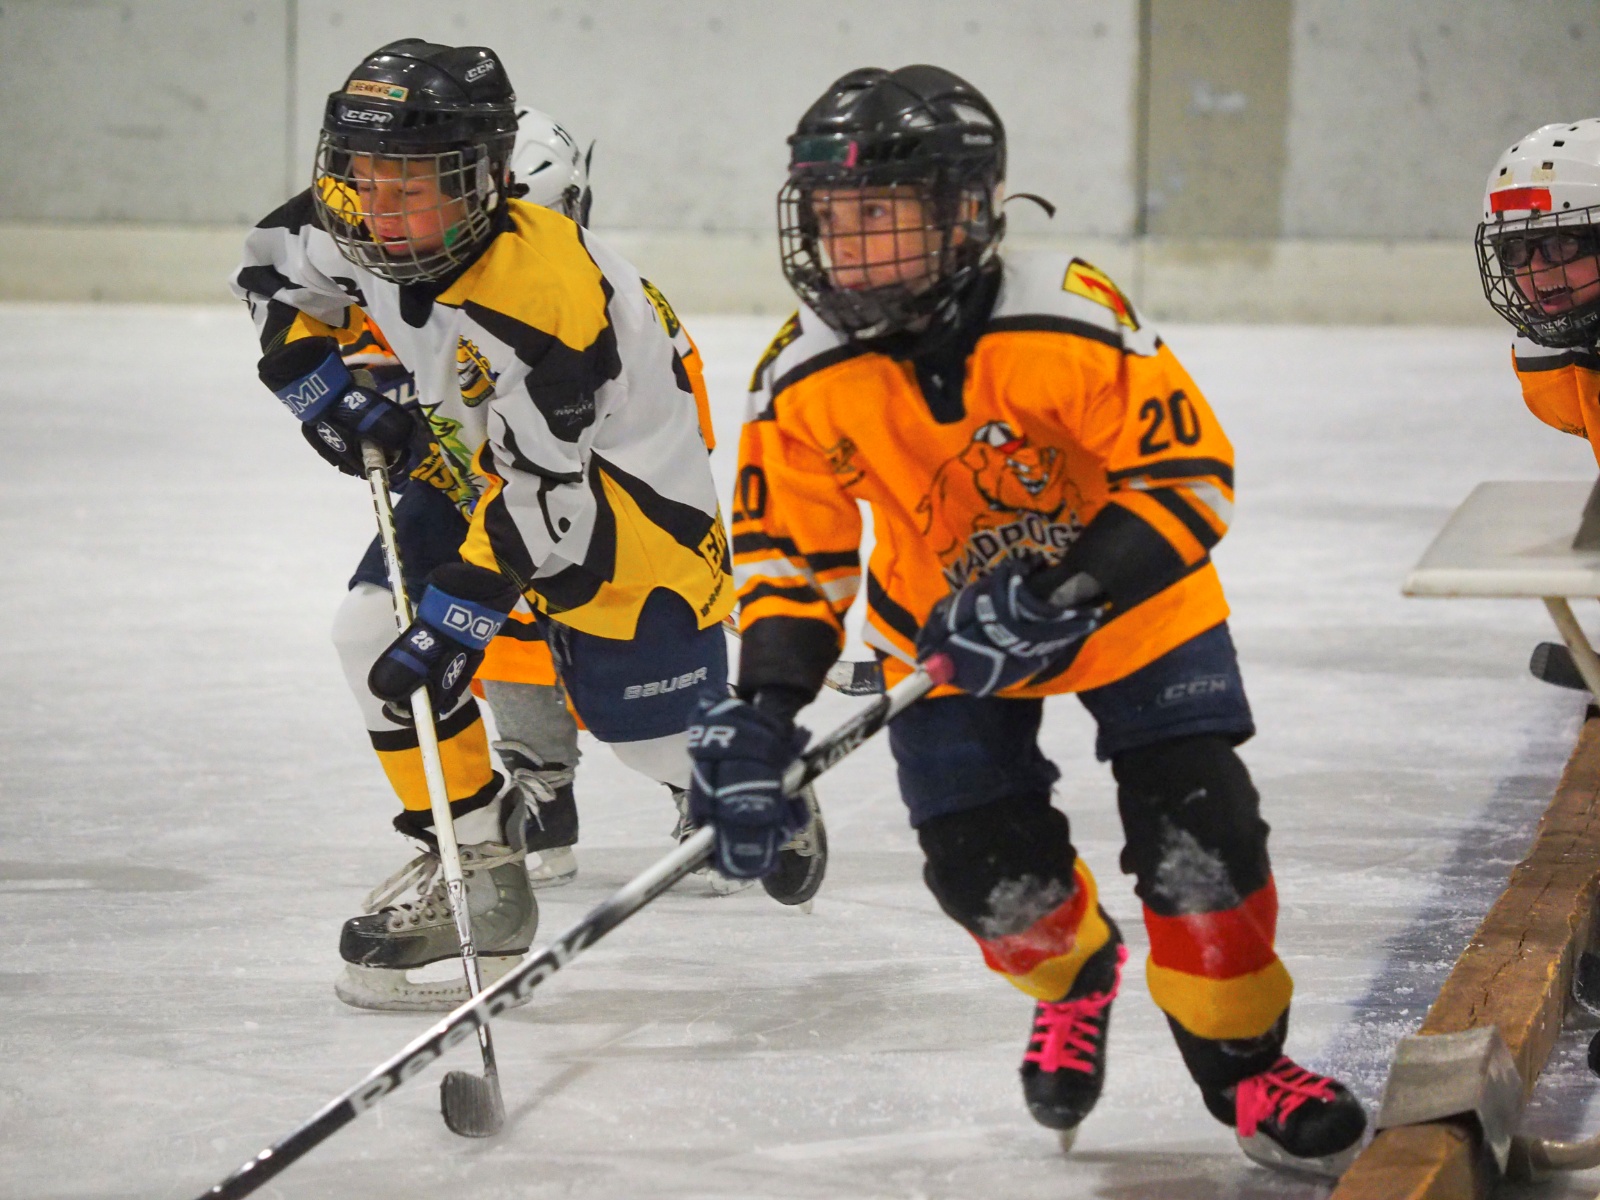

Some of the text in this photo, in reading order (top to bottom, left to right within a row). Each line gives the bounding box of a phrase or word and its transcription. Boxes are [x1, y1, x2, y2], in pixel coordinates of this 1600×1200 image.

[467, 61, 495, 79] CCM
[347, 110, 387, 123] CCM
[282, 373, 330, 416] MI
[343, 391, 367, 410] 28
[1139, 389, 1201, 456] 20
[733, 465, 767, 523] 0
[442, 603, 501, 642] DO
[411, 630, 435, 651] 28
[1164, 679, 1226, 700] CCM
